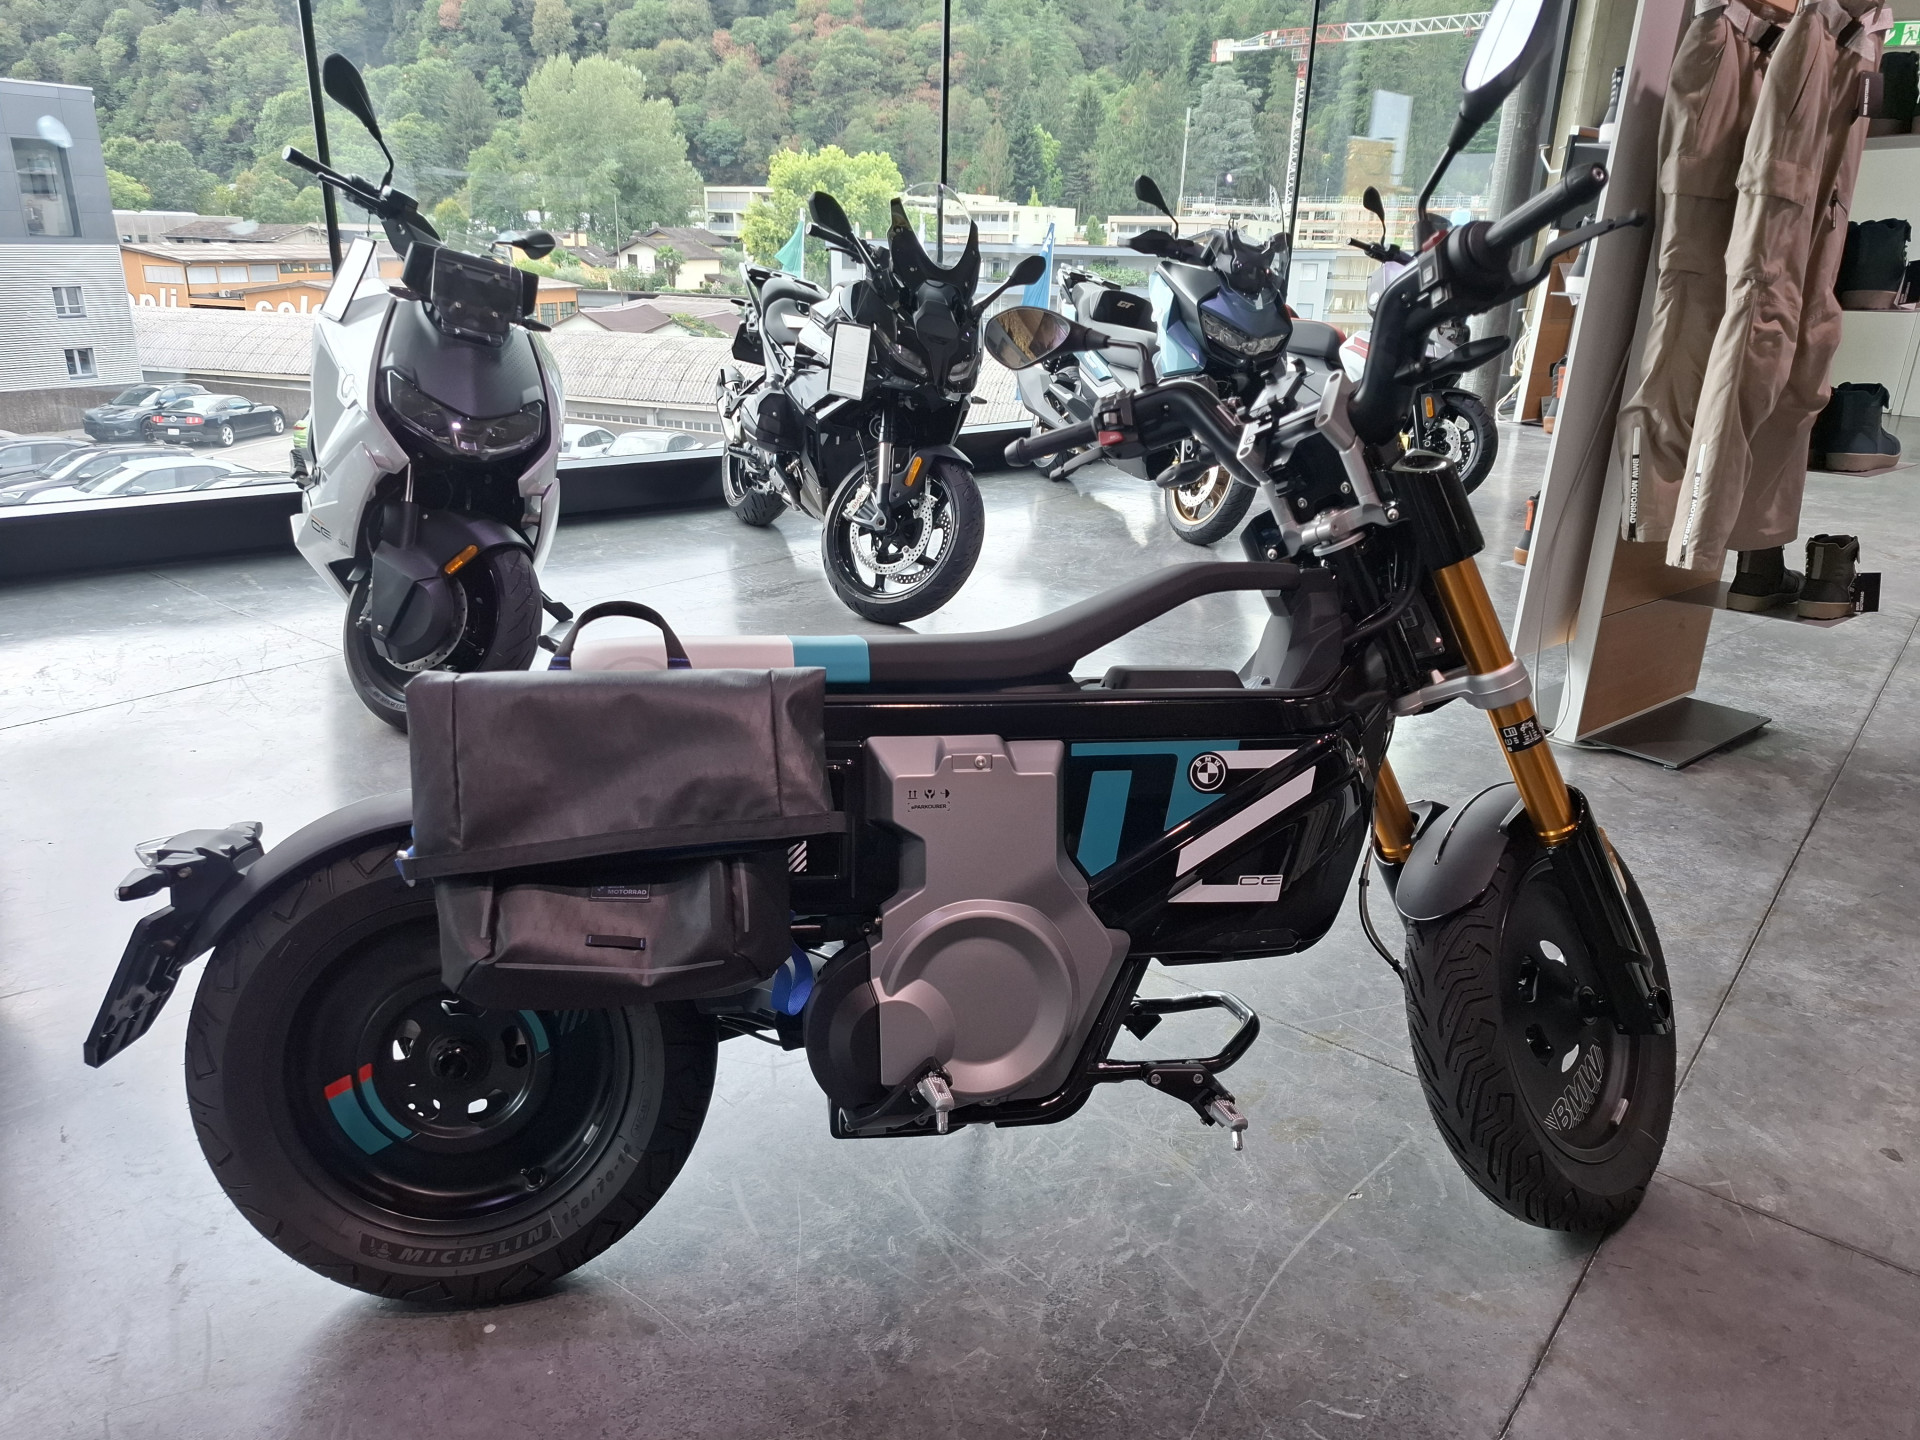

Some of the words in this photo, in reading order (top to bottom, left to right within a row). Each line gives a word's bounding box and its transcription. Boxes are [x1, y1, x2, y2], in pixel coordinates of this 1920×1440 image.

[1632, 458, 1640, 479] BMW
[1693, 476, 1701, 498] BMW
[1629, 479, 1639, 524] MOTORRAD
[311, 519, 332, 541] CE
[1682, 499, 1698, 546] MOTORRAD
[1551, 1045, 1603, 1131] BMW
[398, 1226, 543, 1264] MICHELIN
